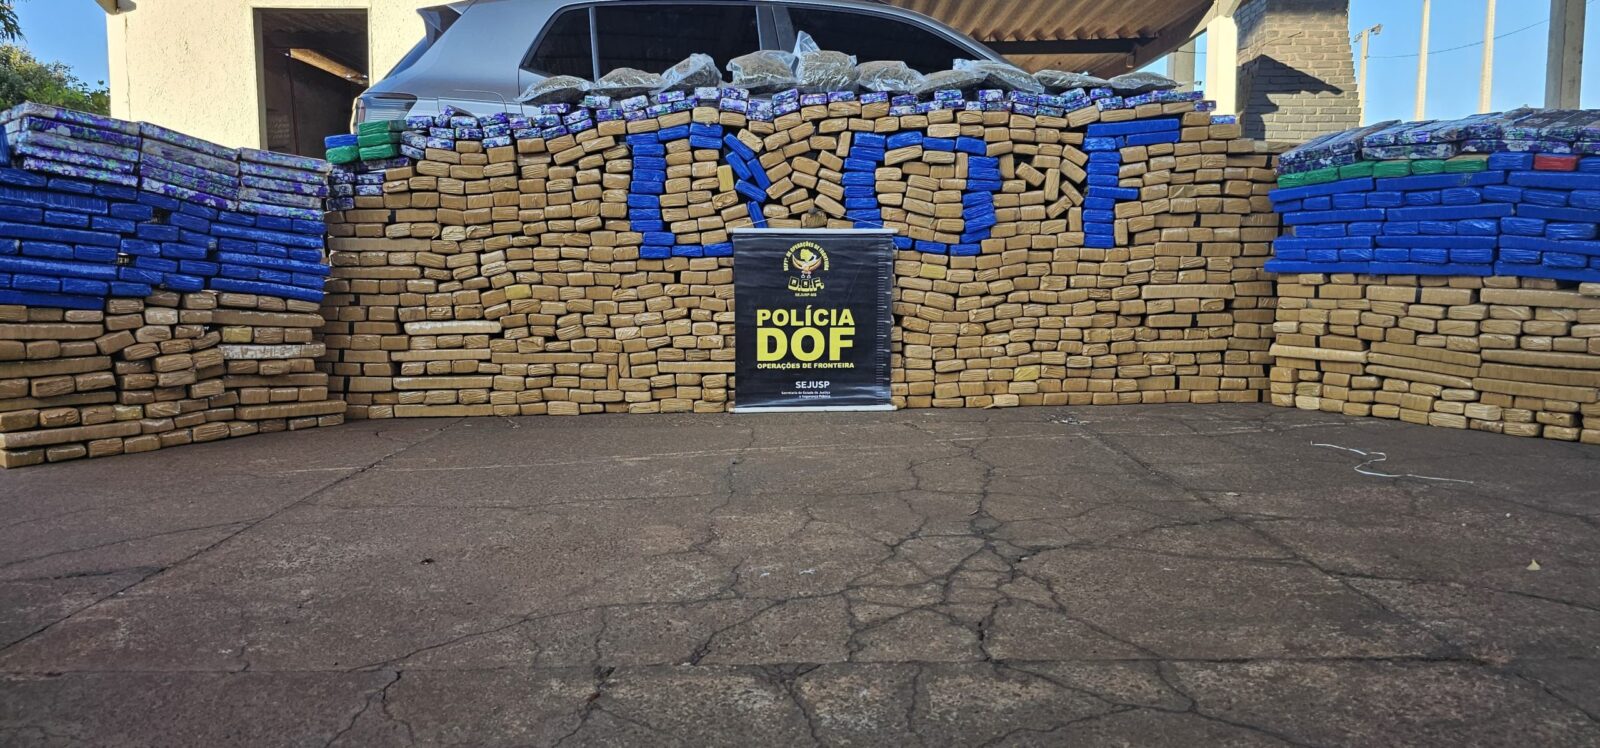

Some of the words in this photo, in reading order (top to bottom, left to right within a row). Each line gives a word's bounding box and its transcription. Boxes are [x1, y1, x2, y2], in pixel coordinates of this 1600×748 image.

[756, 305, 855, 327] POLÍCIA
[756, 326, 856, 362] DOF
[757, 362, 801, 370] OPERAÇÕES
[795, 381, 830, 389] SEJUSP
